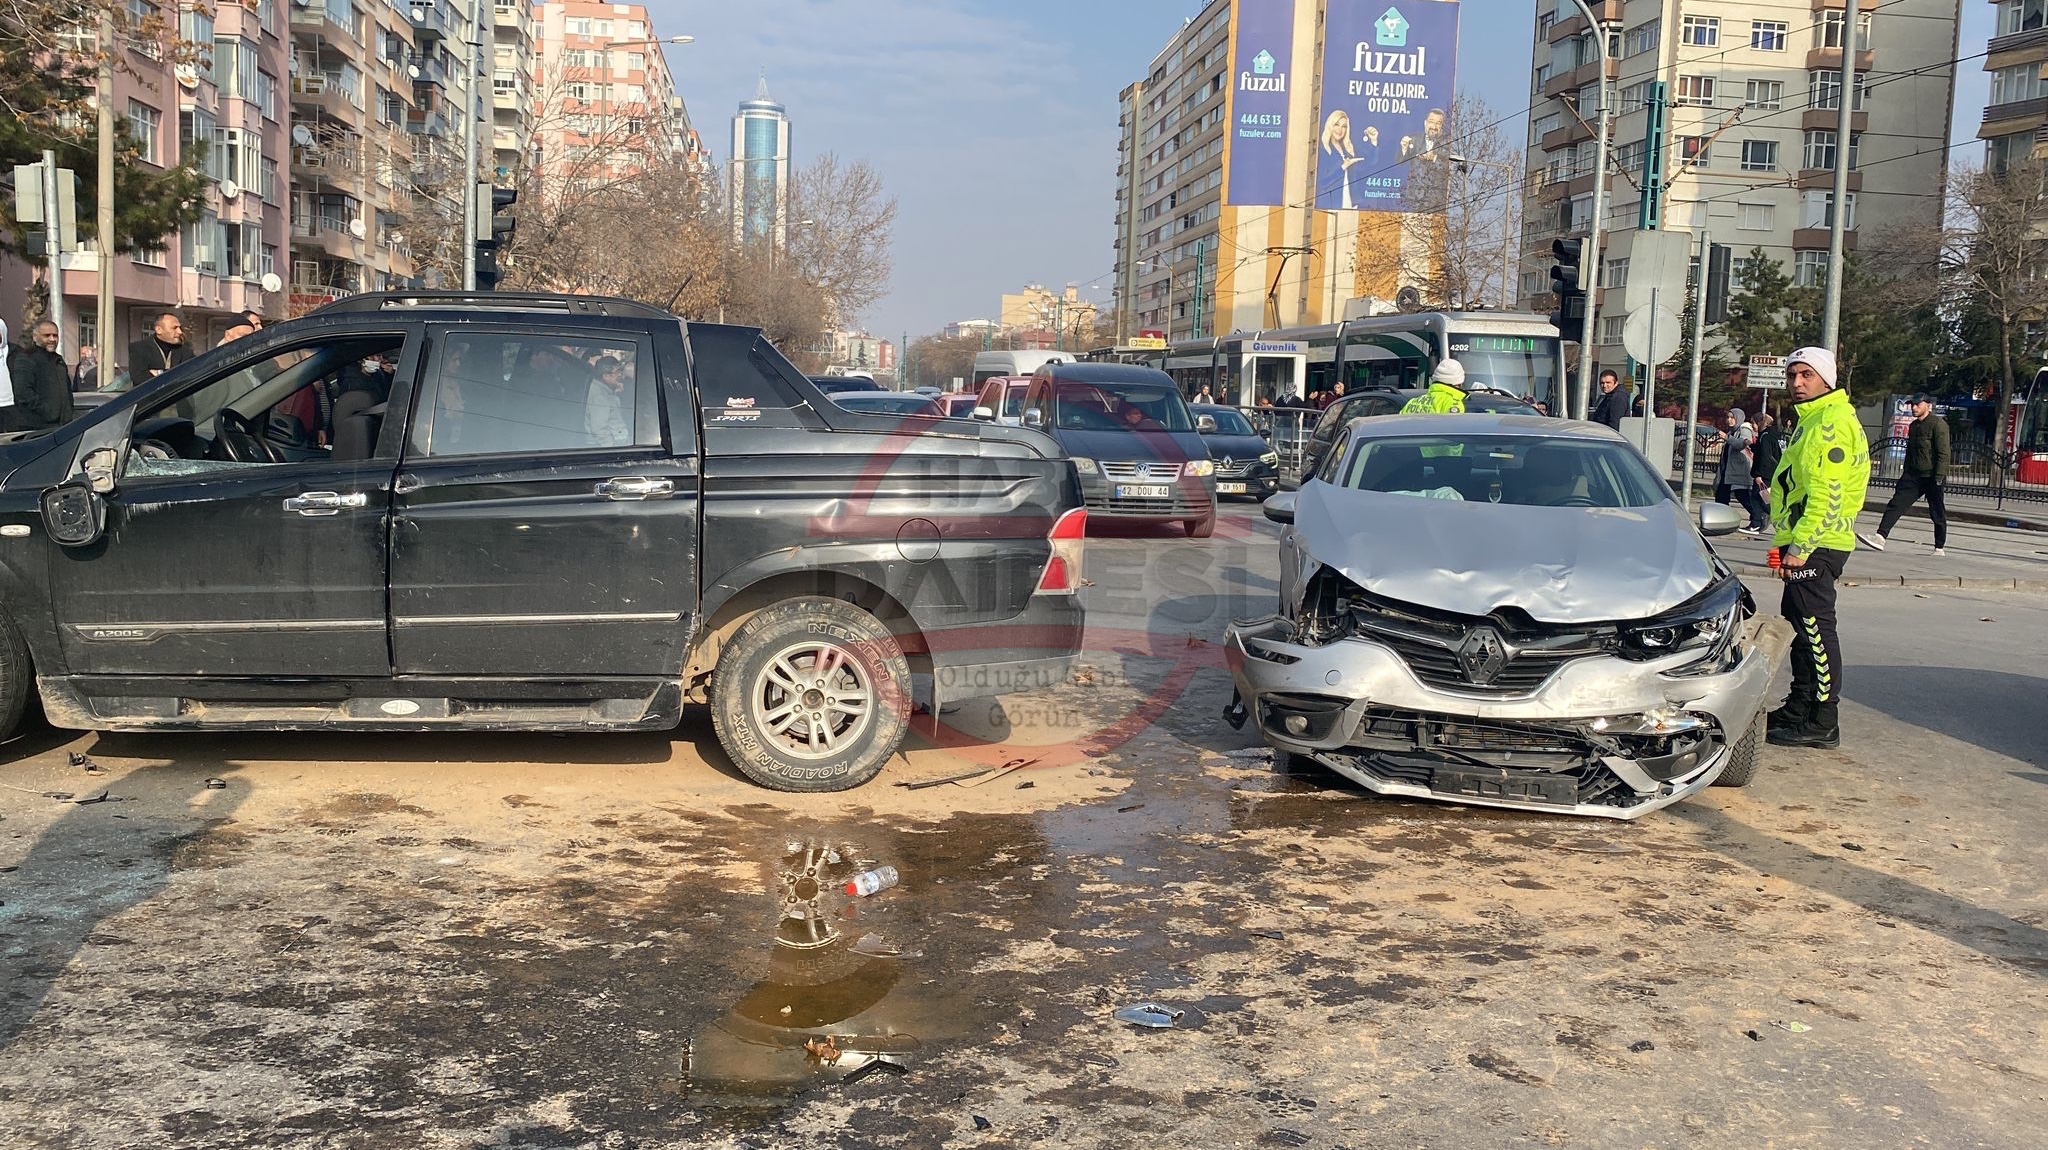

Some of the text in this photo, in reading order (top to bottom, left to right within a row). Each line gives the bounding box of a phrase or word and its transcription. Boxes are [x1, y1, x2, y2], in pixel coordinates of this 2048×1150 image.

[1353, 41, 1426, 76] fuzul
[1240, 71, 1286, 92] fuzul
[1348, 80, 1429, 99] EV DE ALDIRIR.
[1368, 97, 1411, 114] OTO DA.
[1241, 113, 1282, 126] 444 63 13
[1240, 128, 1282, 139] fuzulev.com
[1366, 177, 1402, 188] 444 63 13
[1252, 341, 1298, 353] Güvenlik
[1449, 343, 1469, 352] 4202
[1121, 486, 1132, 495] 42
[1157, 486, 1168, 496] 44
[807, 622, 890, 682] NEXEN
[732, 712, 849, 780] ROADIAN HTX
